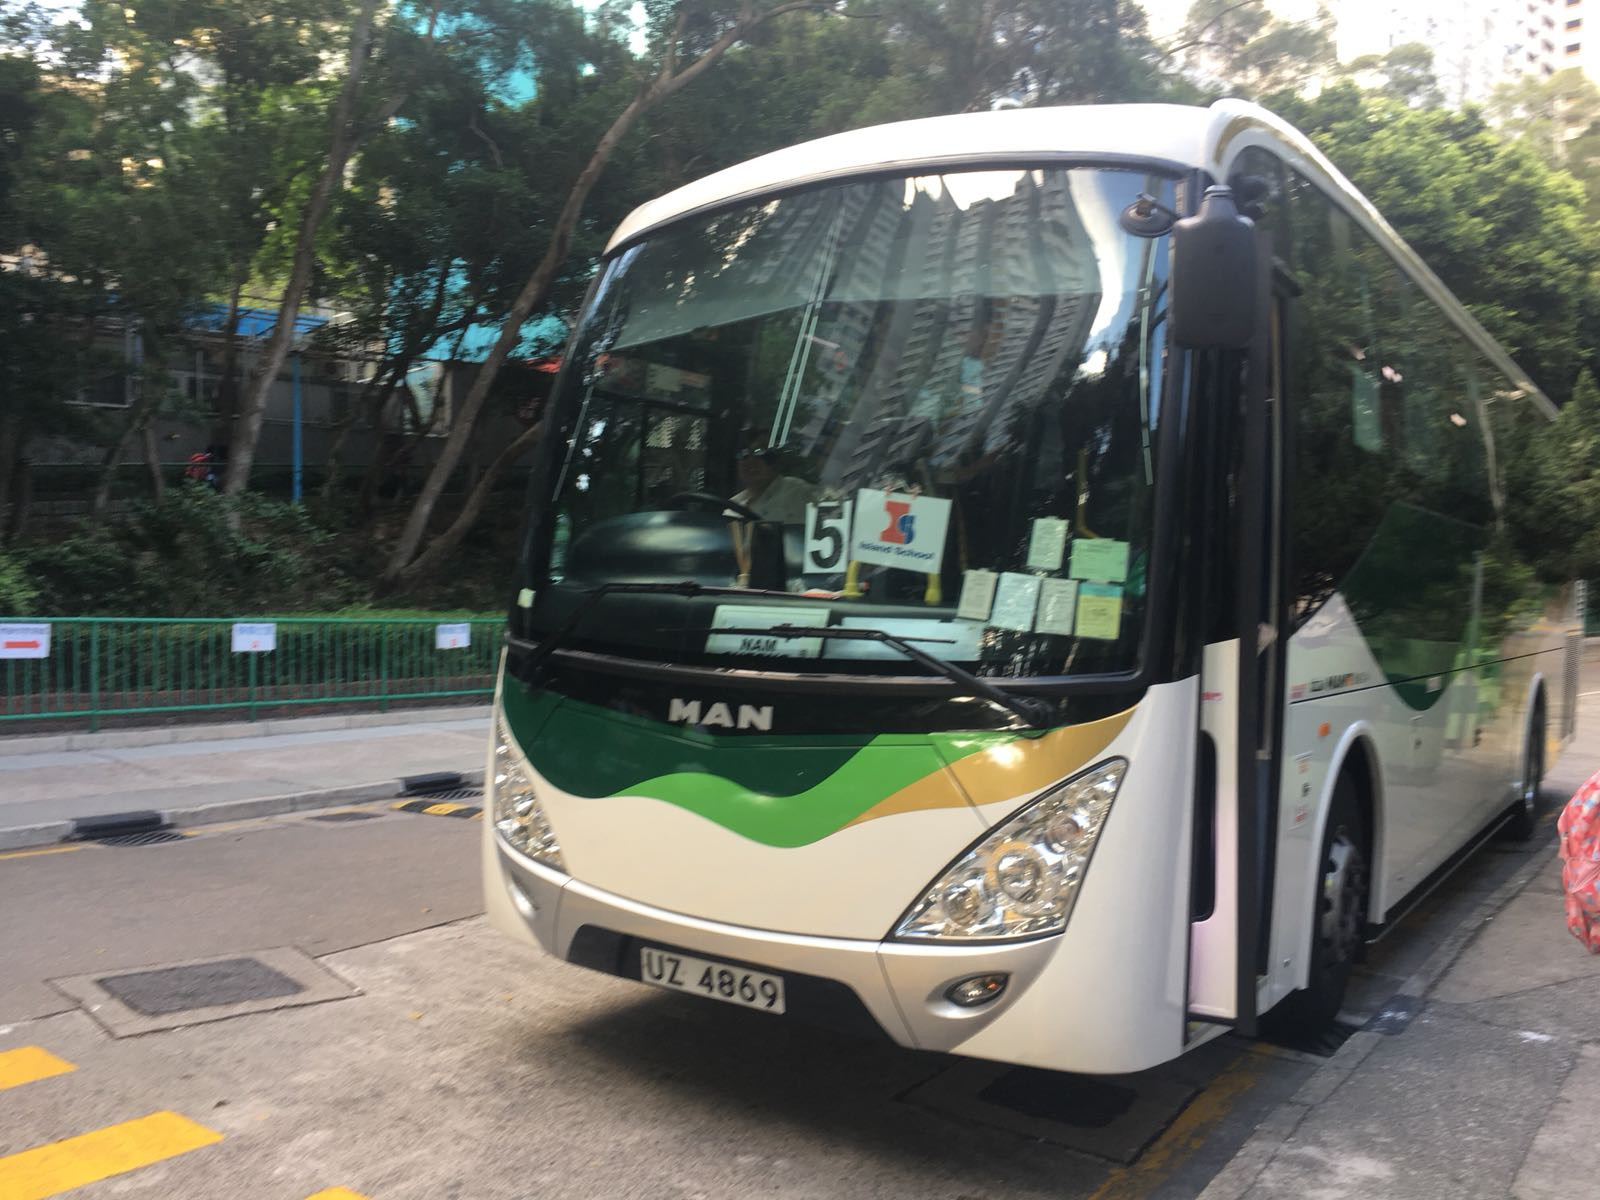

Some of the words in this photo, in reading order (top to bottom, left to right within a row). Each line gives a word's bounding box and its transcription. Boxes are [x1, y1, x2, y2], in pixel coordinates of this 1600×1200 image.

[810, 506, 843, 569] 5
[859, 541, 893, 554] Island
[895, 546, 936, 560] School
[667, 697, 775, 731] MAN
[645, 951, 684, 986] UZ
[697, 964, 779, 1009] 4869
